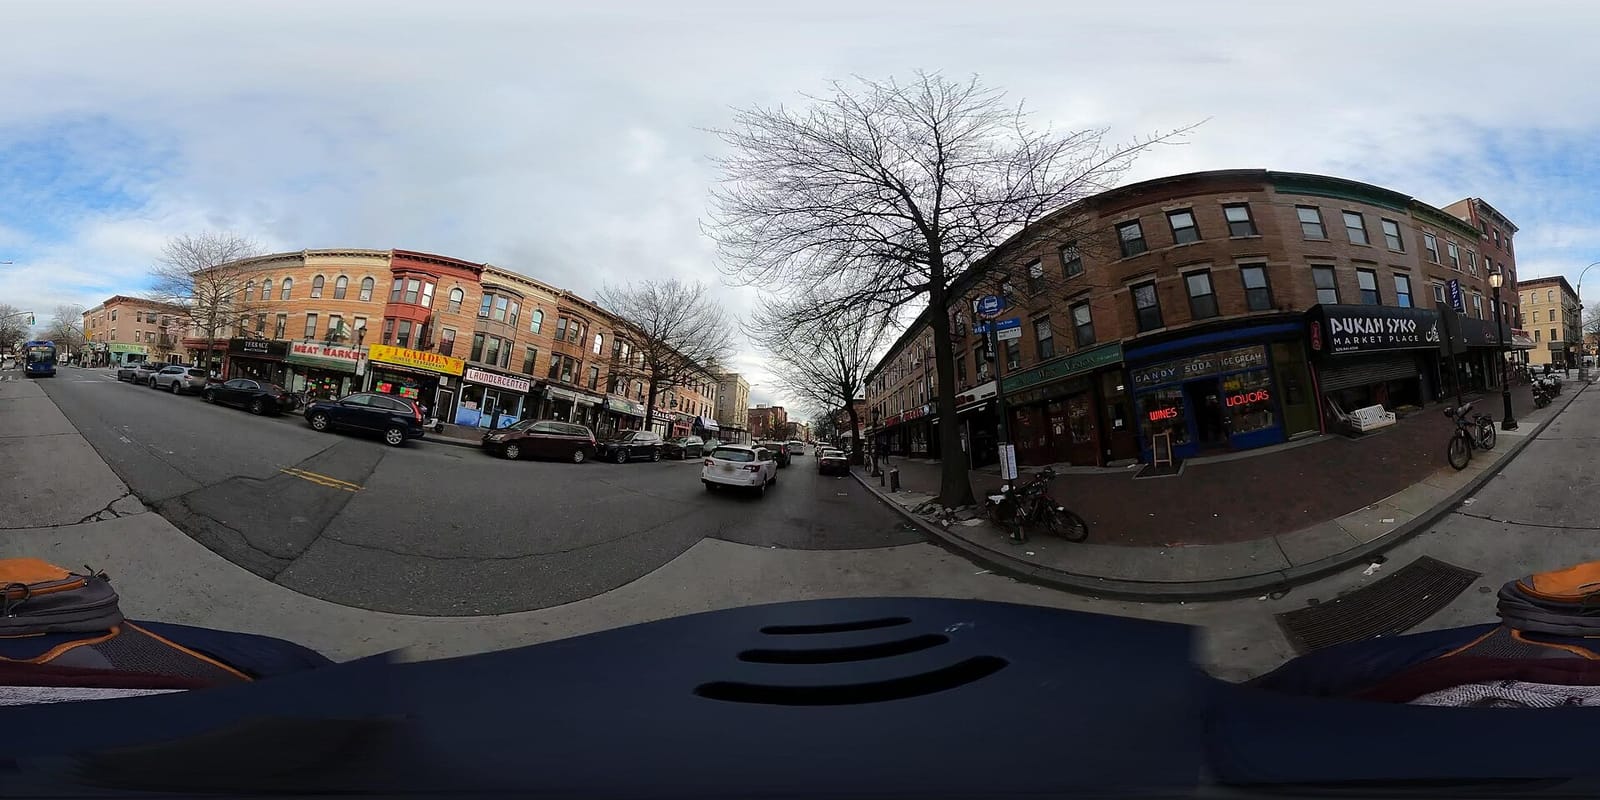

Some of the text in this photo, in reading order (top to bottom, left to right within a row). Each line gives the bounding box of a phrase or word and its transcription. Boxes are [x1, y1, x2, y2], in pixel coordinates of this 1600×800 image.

[1386, 317, 1417, 334] SYKO
[1333, 334, 1420, 346] MARKET PLACE
[293, 344, 366, 360] MEAT MARKET
[403, 349, 449, 365] GARDEN
[1135, 352, 1263, 383] CANDY SODA ICE CREAM
[469, 369, 528, 391] LAUNDERCENTER
[1225, 389, 1270, 407] LIQUORS
[1148, 407, 1179, 422] WINES
